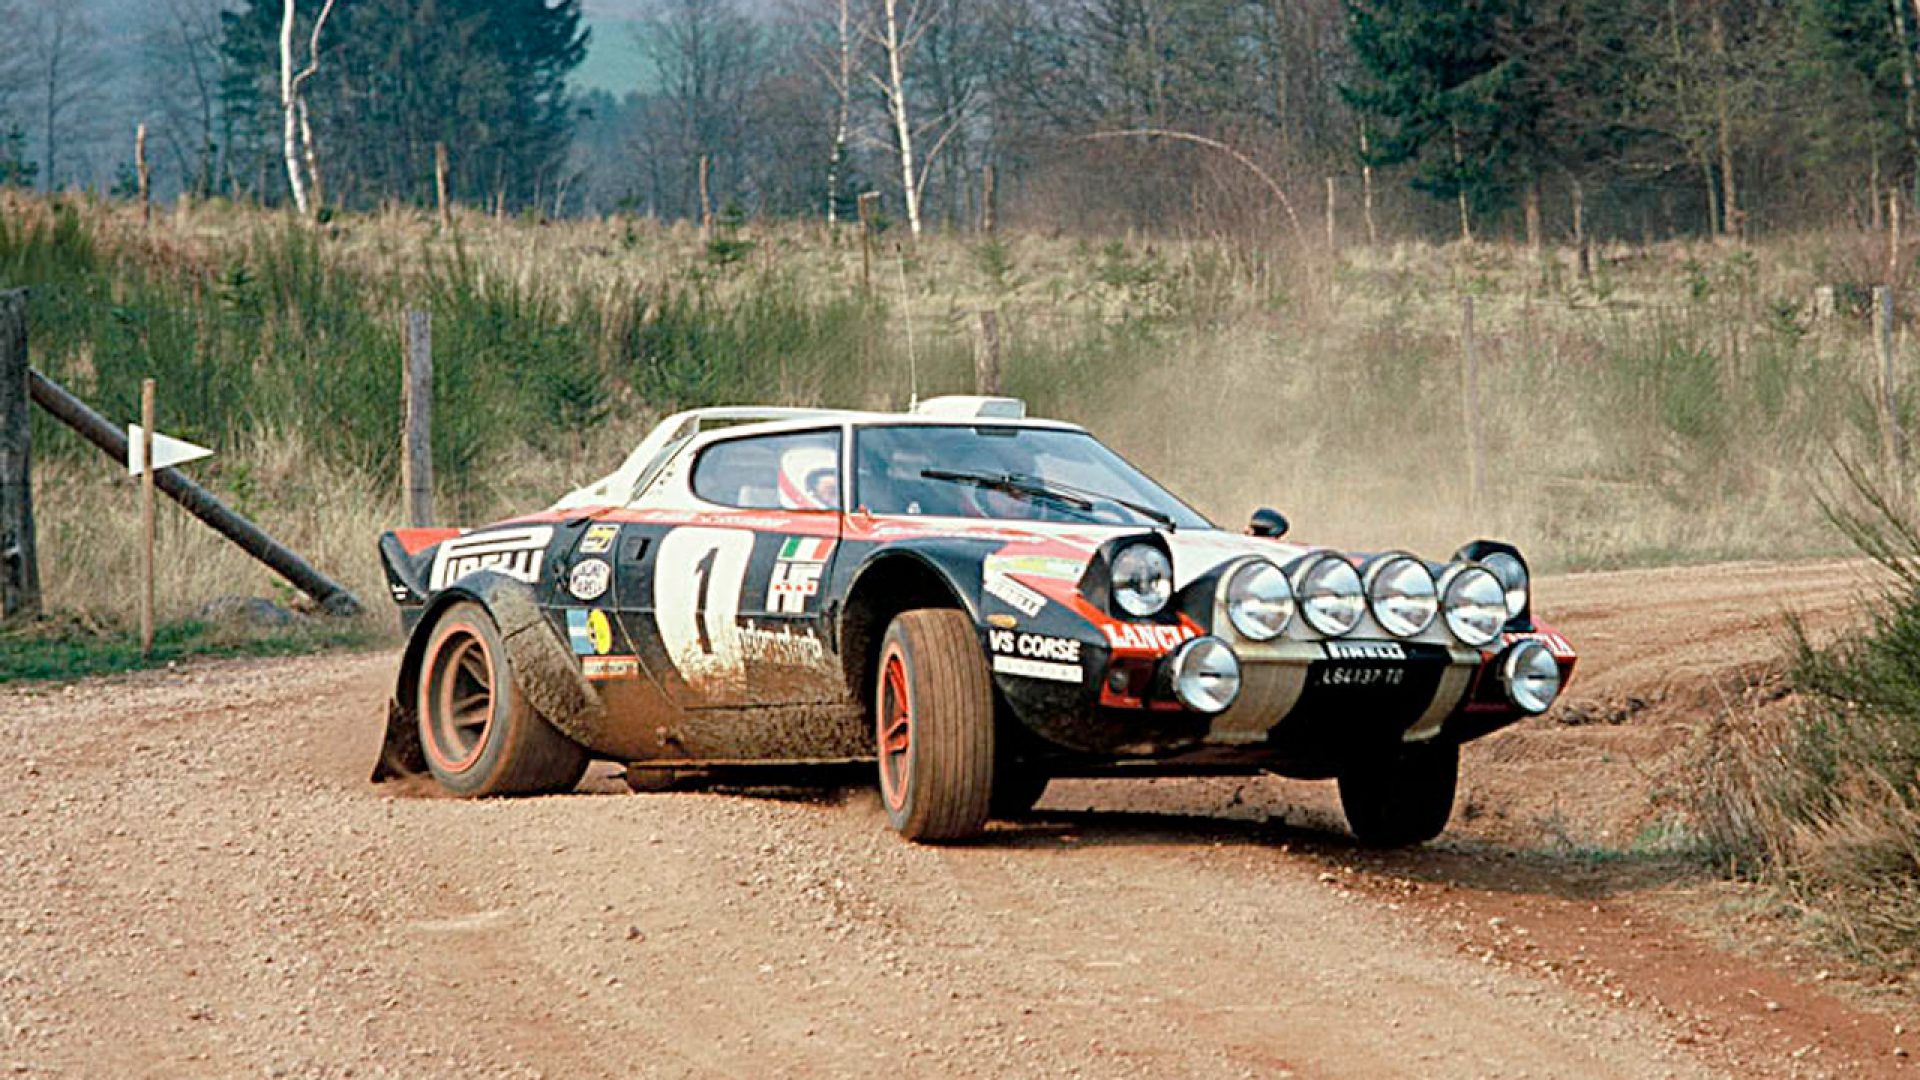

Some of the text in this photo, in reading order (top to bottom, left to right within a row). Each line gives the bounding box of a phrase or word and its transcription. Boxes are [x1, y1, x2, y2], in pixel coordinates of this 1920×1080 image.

[694, 547, 720, 654] 1
[766, 562, 824, 613] HF
[989, 629, 1081, 662] VS CORSE
[1326, 642, 1407, 660] PIRELLI
